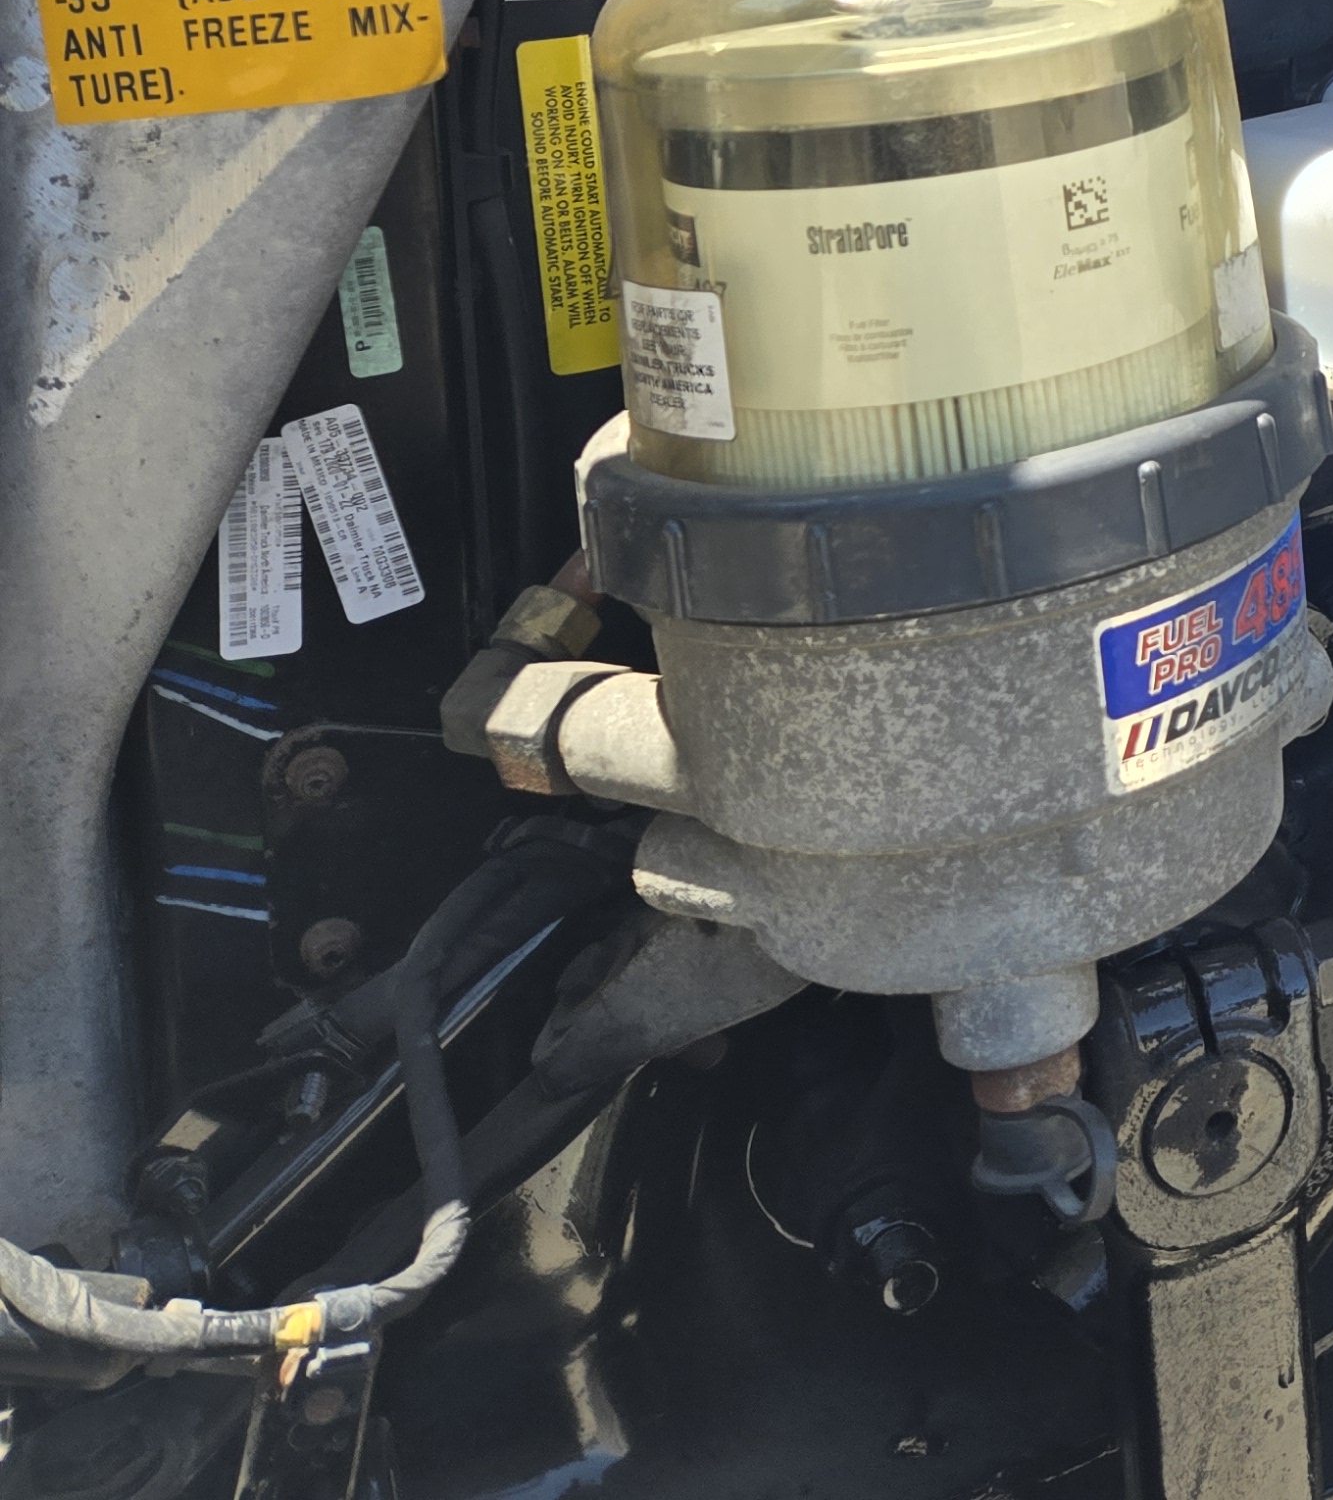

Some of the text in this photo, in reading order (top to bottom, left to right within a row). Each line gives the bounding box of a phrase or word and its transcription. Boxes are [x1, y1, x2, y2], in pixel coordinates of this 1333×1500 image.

[63, 2, 430, 62] ANTI FREEZE MIX-
[531, 111, 563, 312] SOUND BEFORE AUTOMATIC START.
[544, 86, 582, 329] WORKING ON FAN OR BELTS. ALARM WILL
[559, 84, 597, 325] AVOID INJURY, TURN IGNITION OFF WHEN
[575, 81, 610, 323] ENGINE COULD START TO
[806, 222, 909, 255] StrataPore
[1053, 255, 1112, 280] EleMax
[662, 377, 714, 395] AMERICA
[298, 419, 368, 595] MADE IN MEXICO Line A
[343, 513, 364, 553] Daimler
[359, 554, 376, 583] Truck
[369, 583, 383, 599] NA
[1136, 601, 1224, 667] FUEL
[1148, 633, 1224, 695] PRO
[1164, 645, 1281, 744] DAVCO
